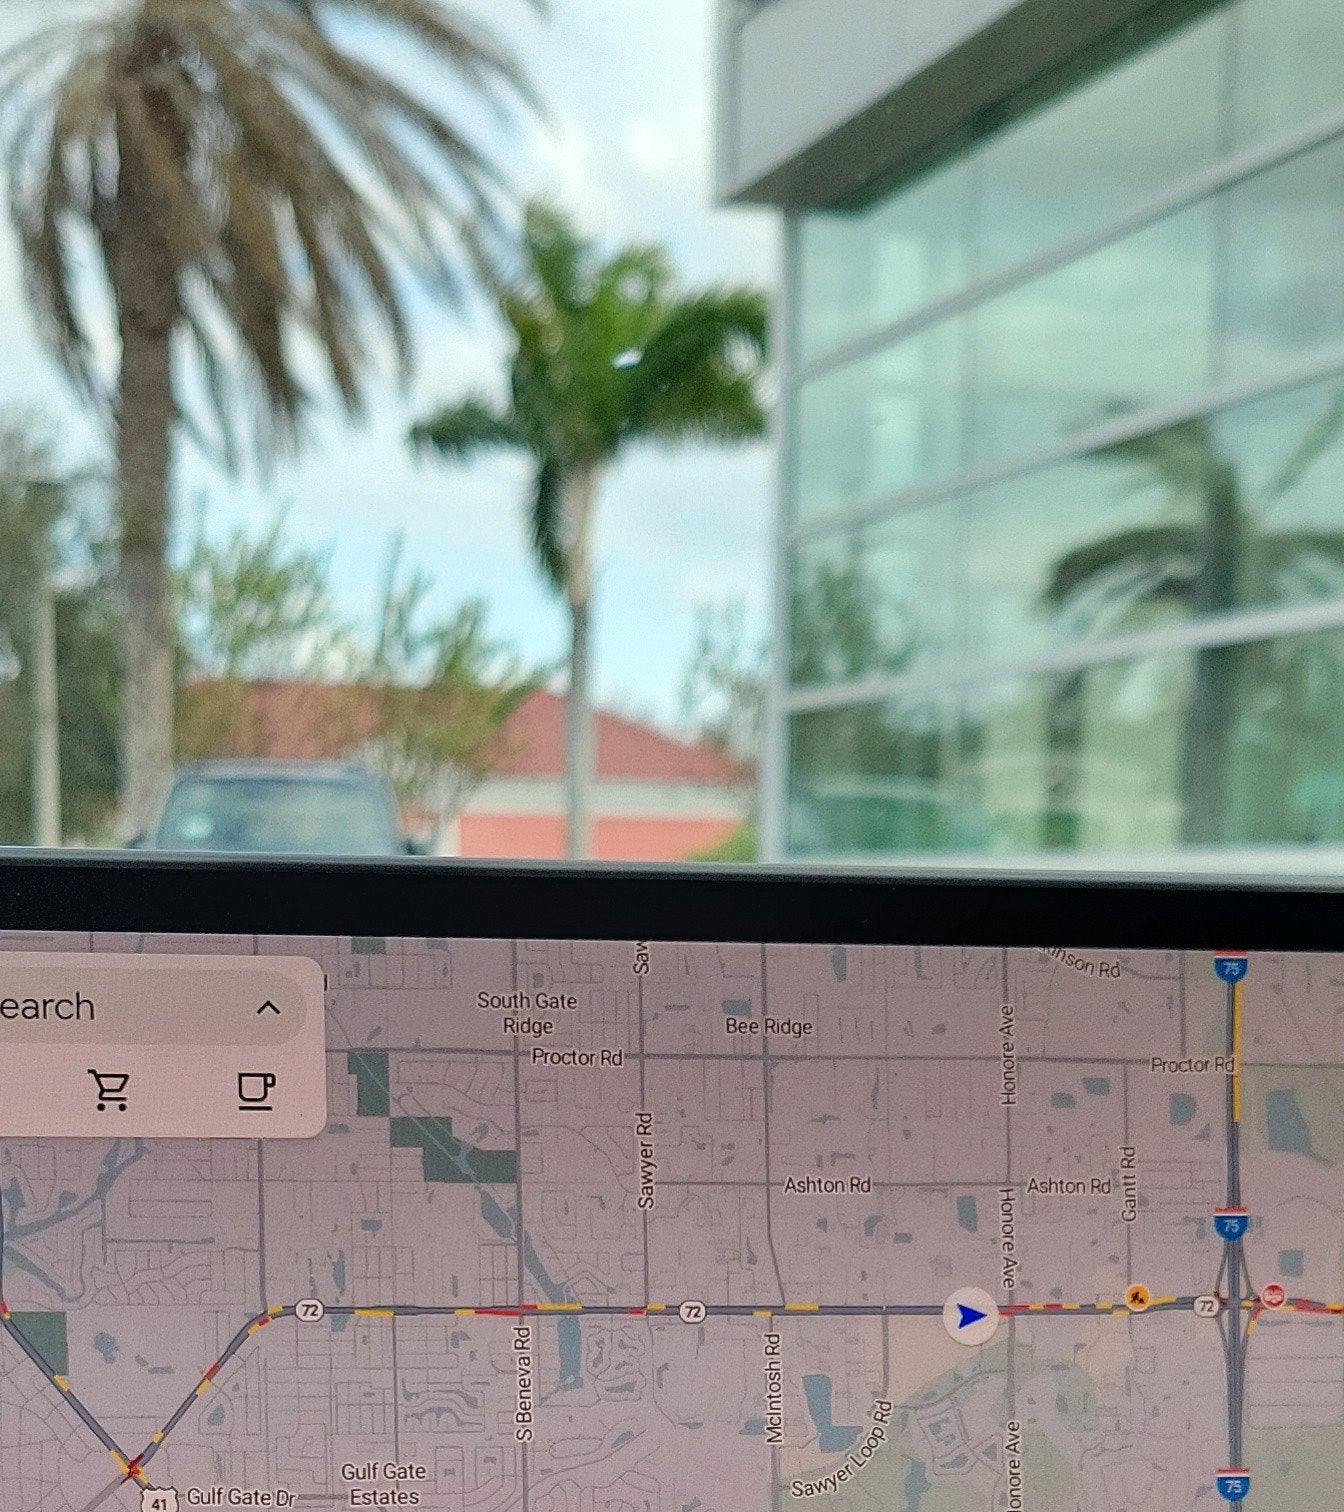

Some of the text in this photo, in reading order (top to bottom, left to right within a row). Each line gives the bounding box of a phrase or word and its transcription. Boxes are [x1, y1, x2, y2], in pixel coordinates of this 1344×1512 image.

[1099, 961, 1121, 978] Rd
[1224, 962, 1240, 975] 75
[477, 992, 578, 1009] South Gate
[504, 1017, 553, 1038] Ridge
[726, 1018, 813, 1038] Bee Ridge
[532, 1048, 623, 1067] Proctor Rd
[999, 1005, 1017, 1105] Honore Ave
[1152, 1057, 1235, 1073] Proctor Rd
[636, 1112, 657, 1209] Sawyer Rd
[785, 1176, 871, 1194] Ashton Rd
[1027, 1178, 1111, 1195] Ashton Rd
[1120, 1147, 1136, 1222] Gantt Rd
[1224, 1219, 1239, 1232] 75
[1000, 1189, 1018, 1289] Honore Ave
[301, 1304, 319, 1317] 72
[684, 1305, 702, 1318] 72
[1199, 1300, 1214, 1313] 72
[513, 1327, 533, 1441] S Beneva Rd
[763, 1334, 783, 1443] McIntosh Rd
[1004, 1421, 1020, 1454] Ave
[791, 1400, 892, 1497] Sawyer Loop Rd
[341, 1463, 427, 1481] Gulf Gate
[1225, 1480, 1241, 1493] 75
[151, 1498, 168, 1511] 41
[187, 1488, 296, 1507] Gulf Gate Dr
[350, 1489, 420, 1506] Estates
